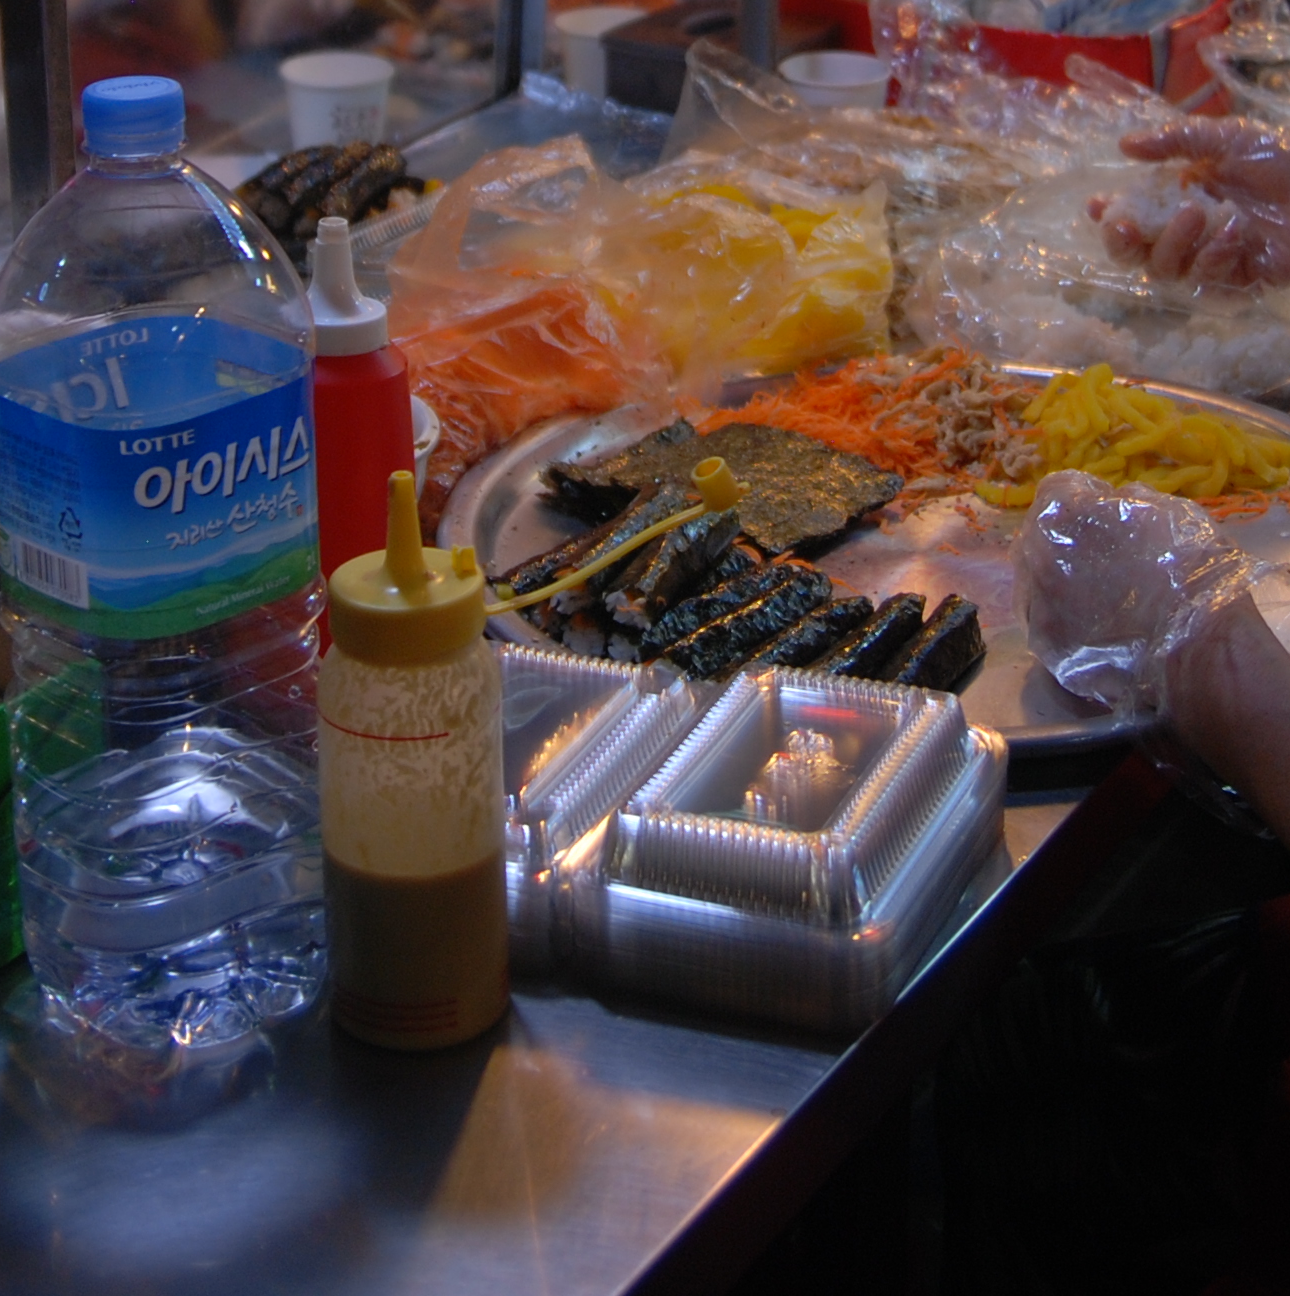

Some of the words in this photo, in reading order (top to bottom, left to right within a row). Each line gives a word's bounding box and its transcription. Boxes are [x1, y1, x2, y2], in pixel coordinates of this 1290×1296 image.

[119, 428, 196, 456] LOTTE
[165, 516, 225, 551] 지리산
[225, 480, 300, 533] 산청수
